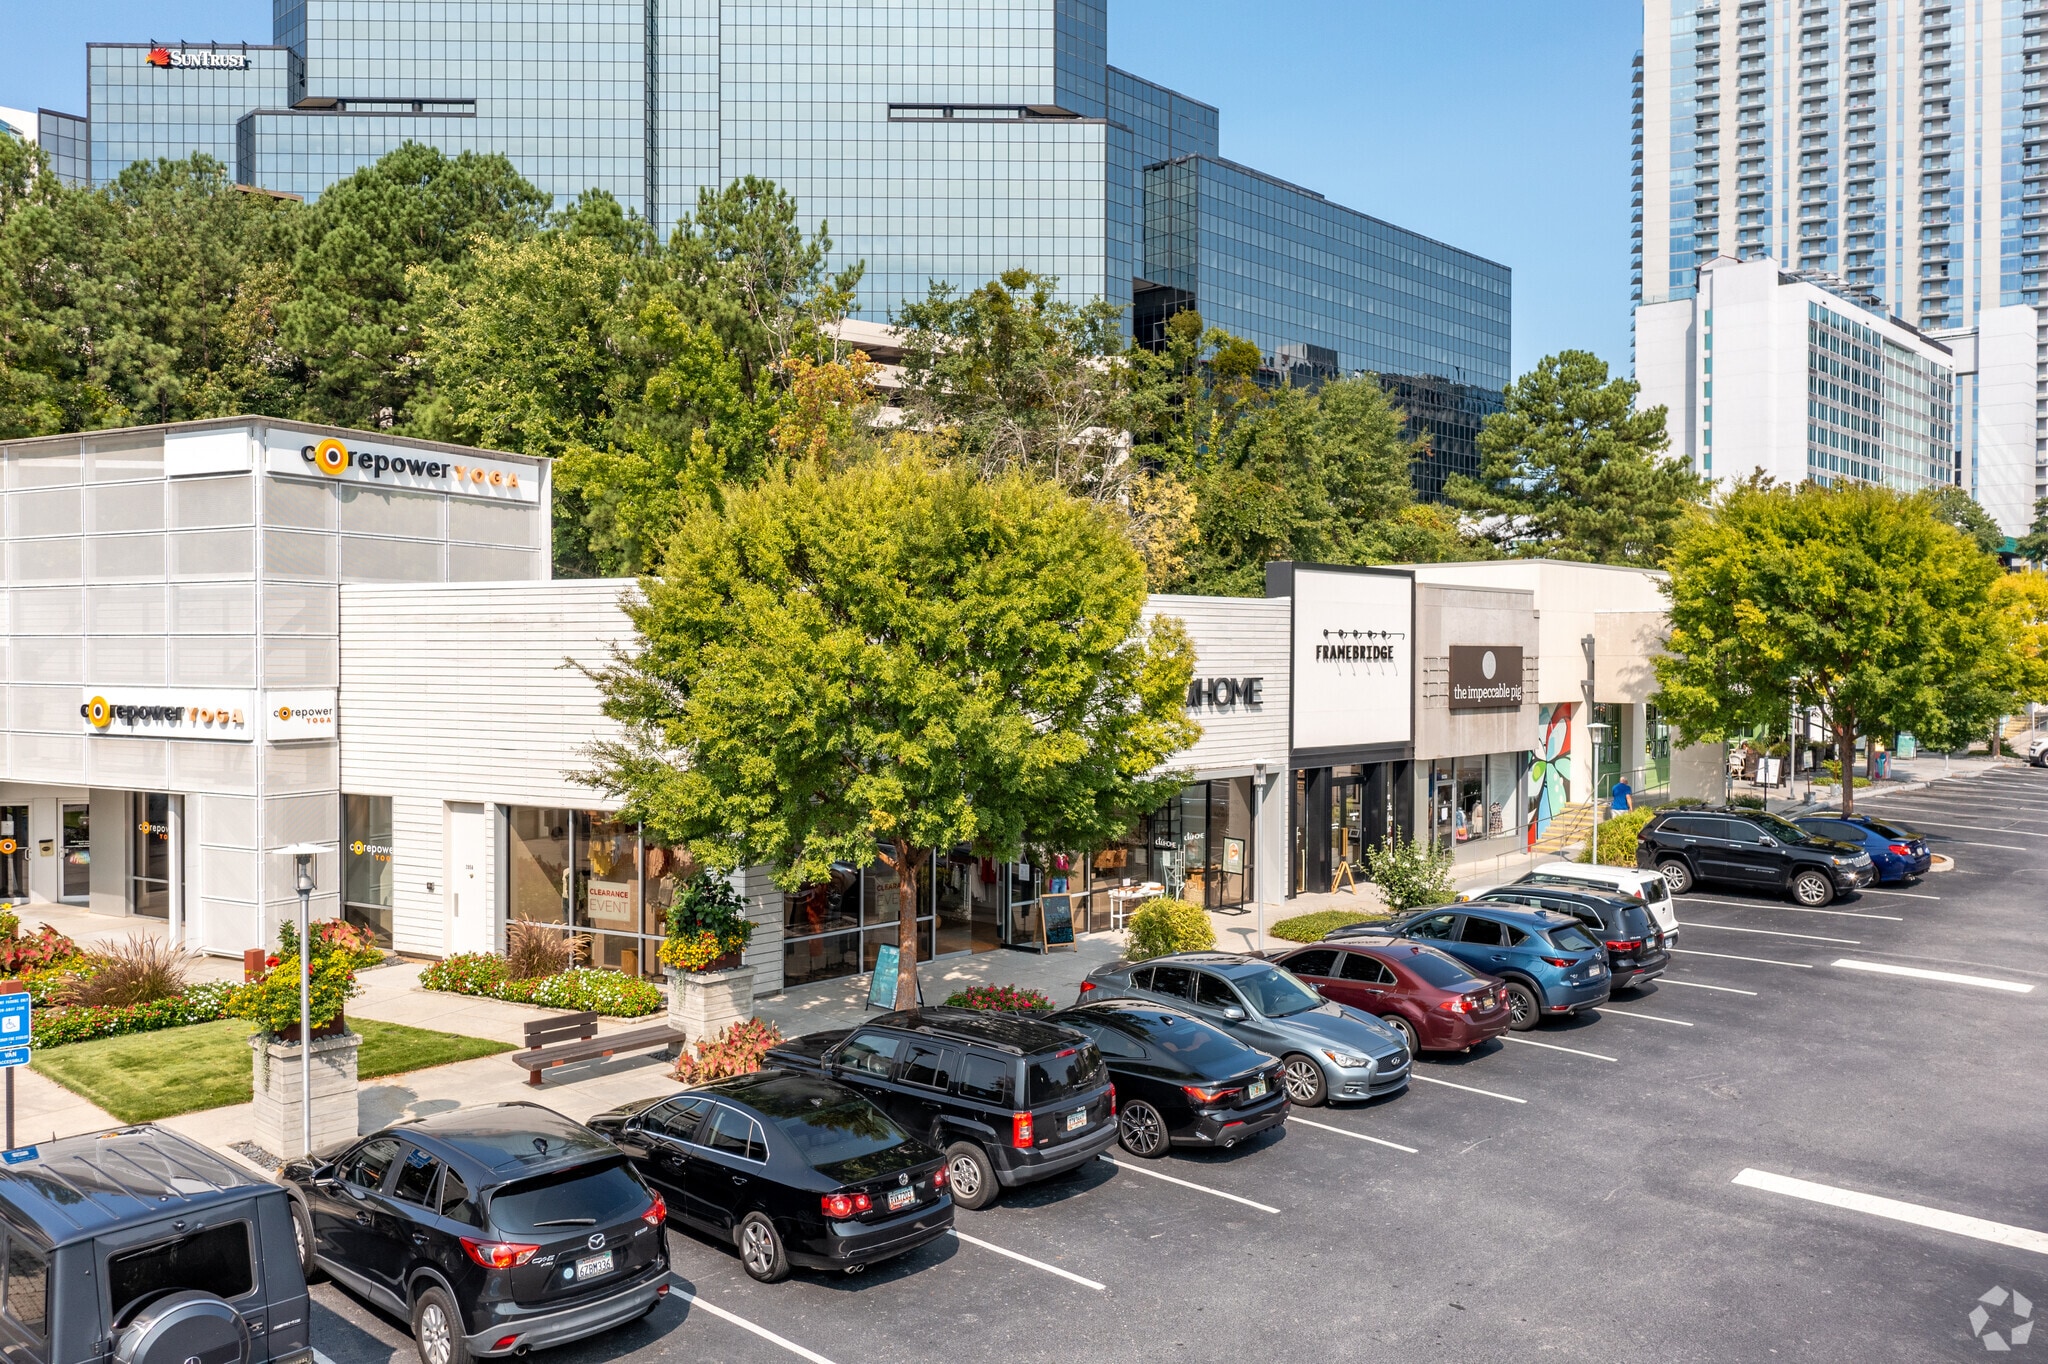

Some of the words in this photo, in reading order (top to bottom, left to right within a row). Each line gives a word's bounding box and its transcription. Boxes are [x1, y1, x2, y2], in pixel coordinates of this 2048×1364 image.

[301, 438, 450, 478] corepower
[454, 465, 519, 488] YOGA
[1316, 645, 1394, 660] FRAMEBRIDGE
[1454, 684, 1467, 699] the
[1468, 683, 1510, 702] impeccable
[1510, 684, 1522, 701] pig
[80, 696, 185, 727] corepower
[187, 708, 245, 724] YOGA
[273, 706, 333, 721] corepower
[350, 840, 393, 856] corepowe
[375, 854, 391, 862] YOG
[589, 888, 629, 899] CLEARANCE
[590, 898, 628, 914] EVENT
